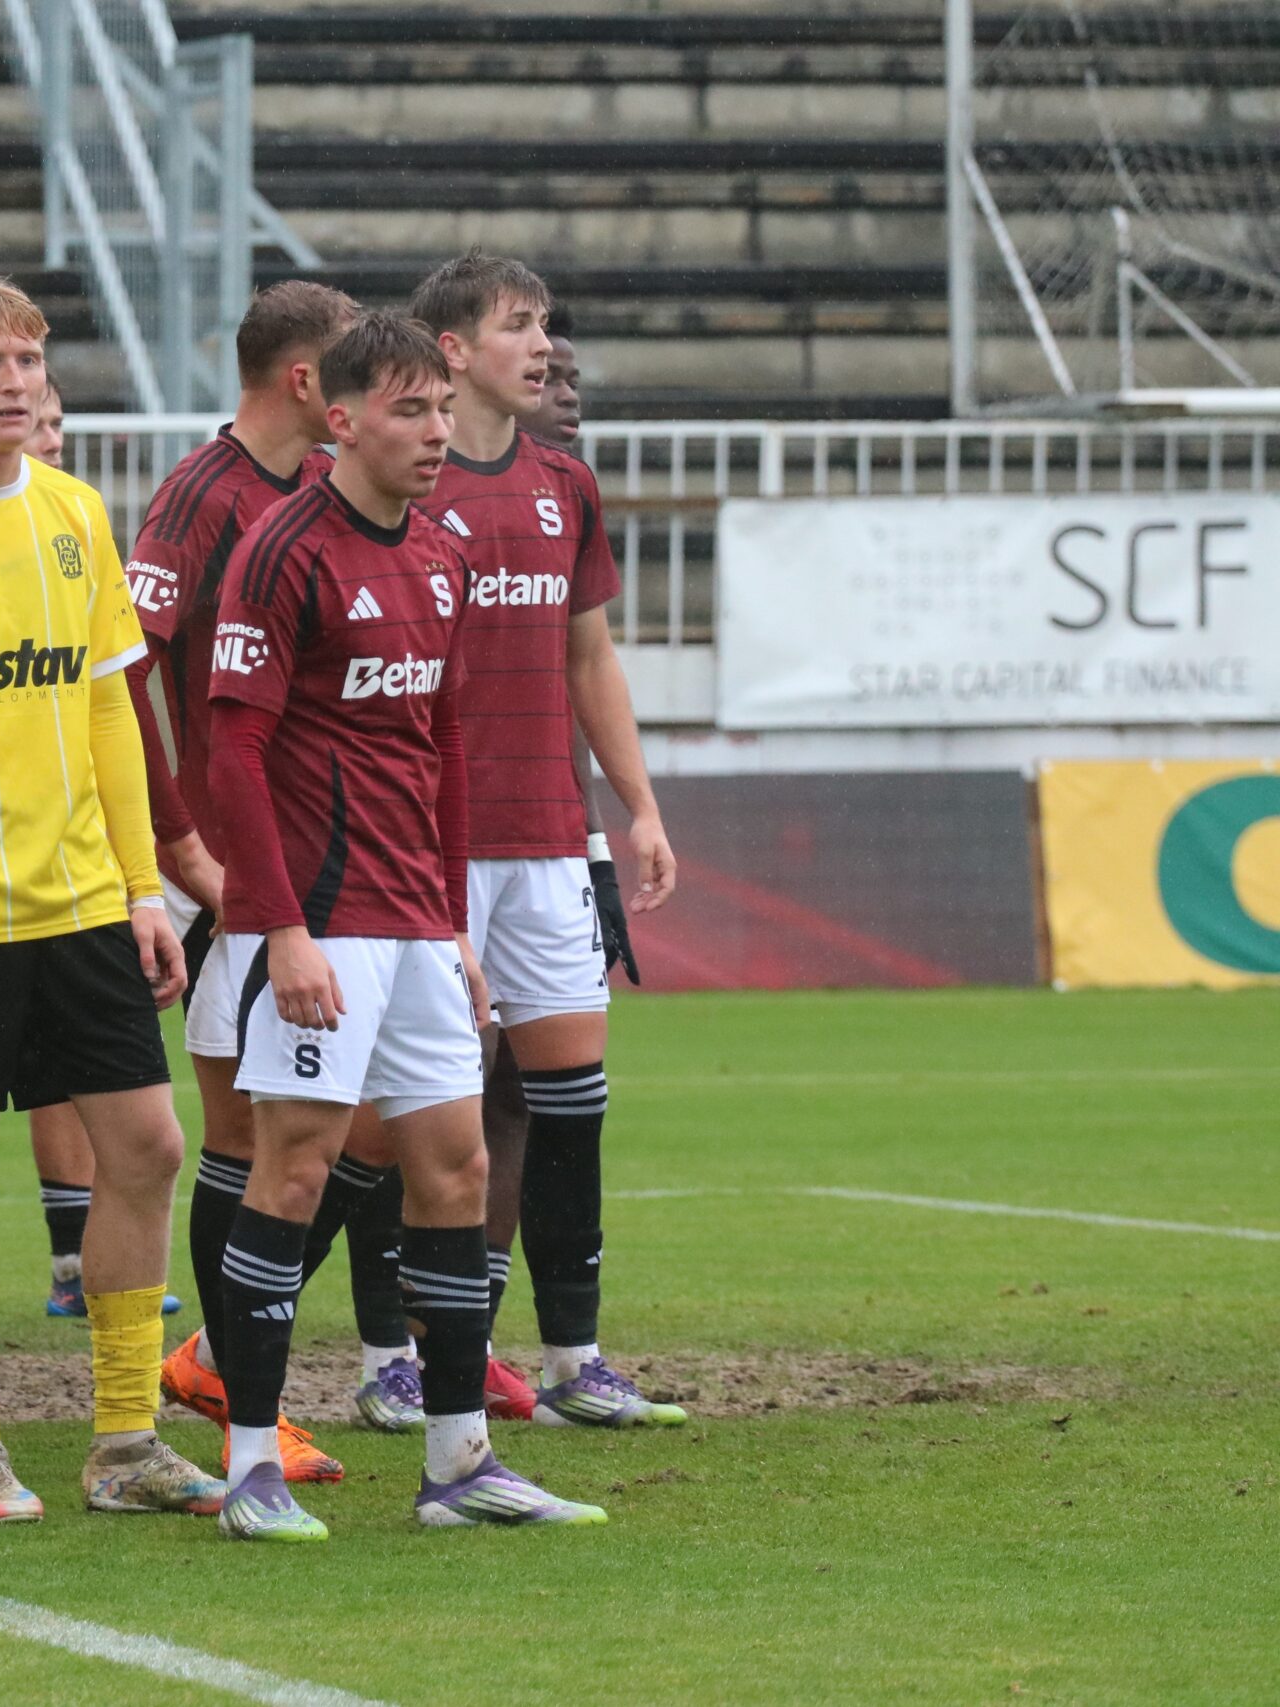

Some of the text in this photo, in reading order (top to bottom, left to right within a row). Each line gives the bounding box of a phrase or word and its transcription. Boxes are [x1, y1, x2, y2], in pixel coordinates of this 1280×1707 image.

[535, 498, 563, 536] S
[429, 574, 454, 617] S
[1049, 519, 1250, 631] SCF
[216, 622, 265, 640] Chance
[341, 652, 446, 700] Betan
[847, 661, 943, 699] STAR
[1101, 656, 1250, 697] FINANCE
[294, 1043, 321, 1079] S
